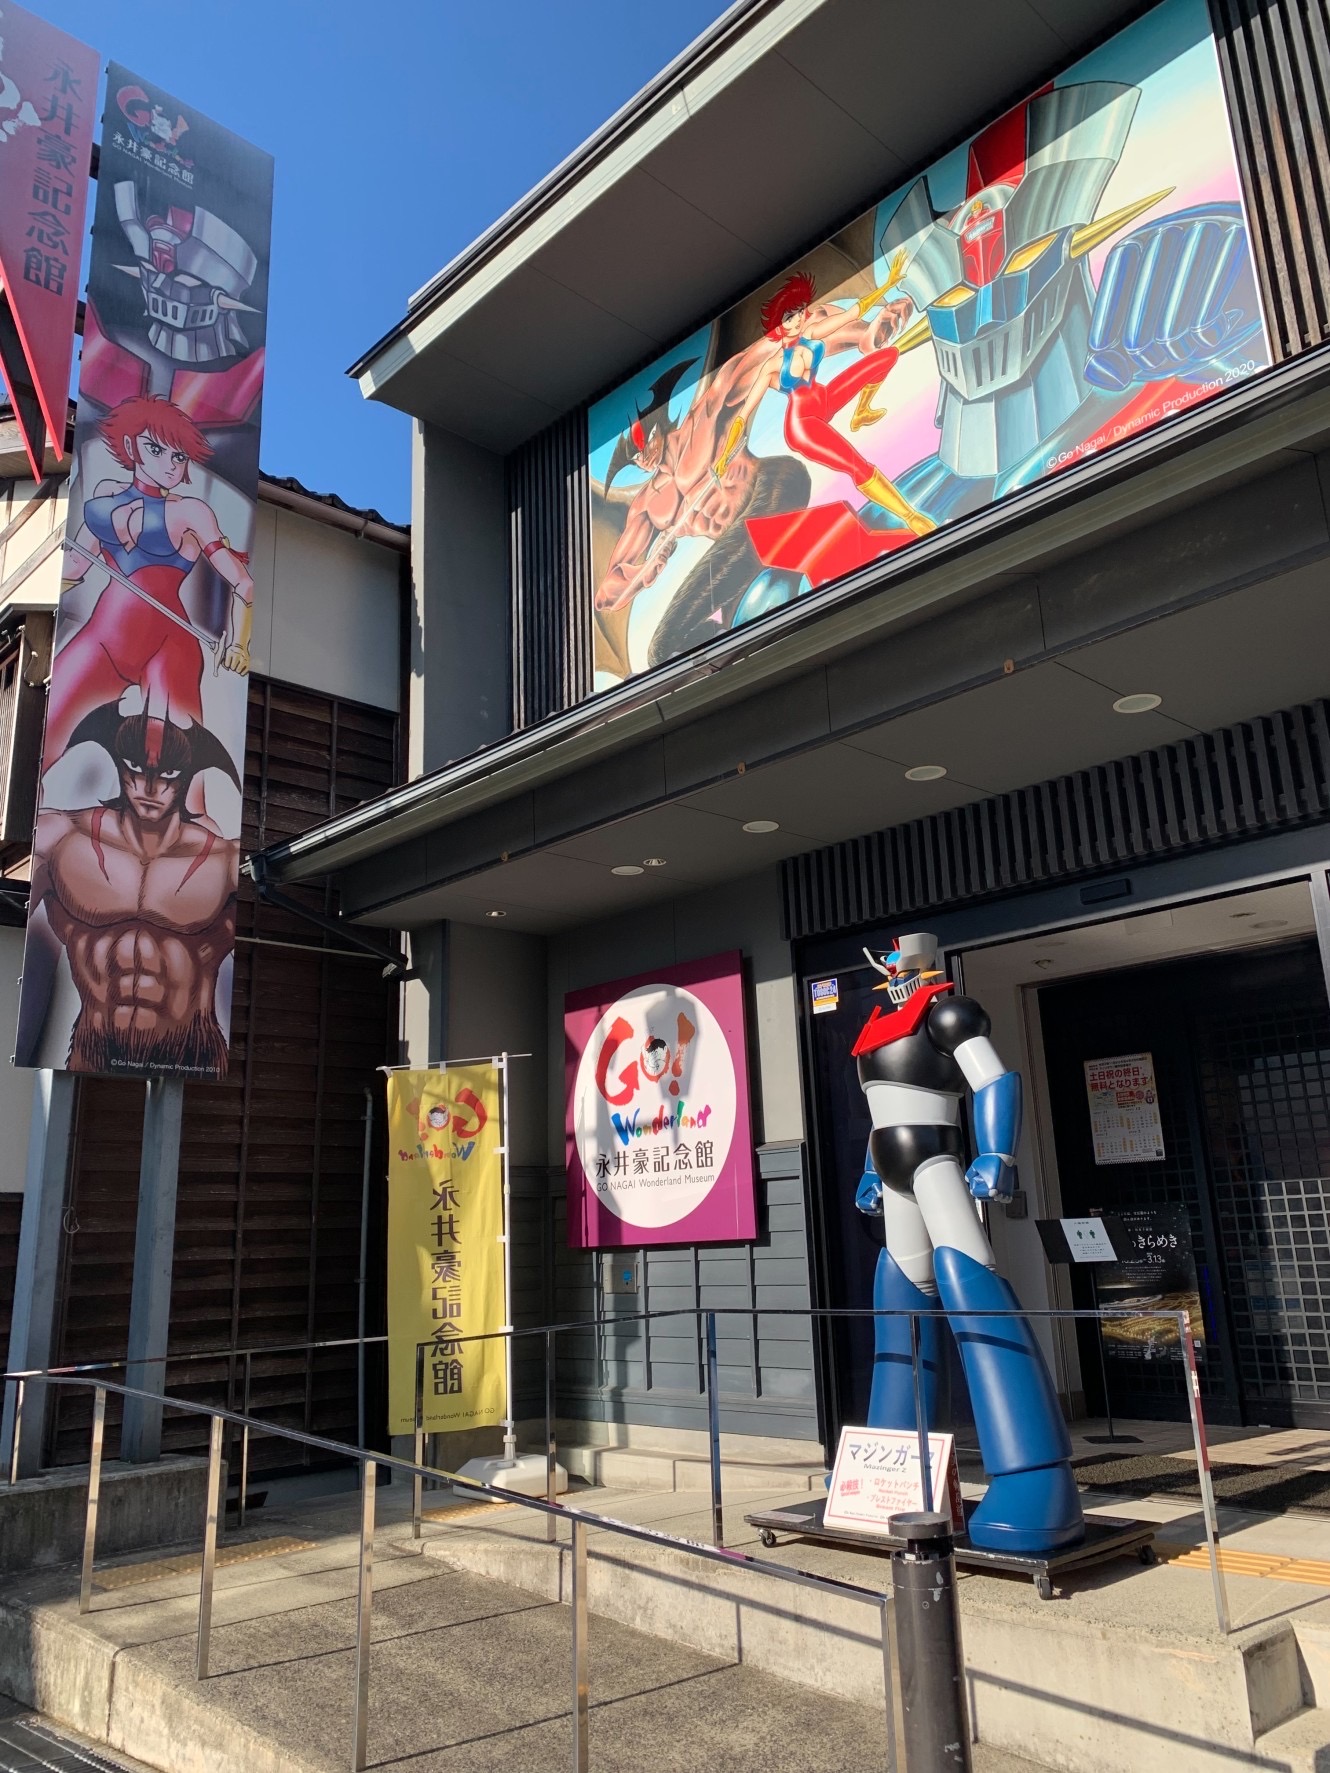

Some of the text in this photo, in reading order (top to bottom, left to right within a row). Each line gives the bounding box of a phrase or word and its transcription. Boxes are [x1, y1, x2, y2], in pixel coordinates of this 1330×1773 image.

[23, 57, 82, 297] 永井豪記念館
[1162, 377, 1224, 412] Production
[1225, 360, 1255, 383] 2020
[149, 1062, 174, 1070] Dynamic
[174, 1063, 205, 1073] Production
[611, 1100, 712, 1146] Wonderland
[595, 1139, 714, 1178] 永井豪記念館
[596, 1173, 715, 1192] GO NAGAI Wonderland Museum
[863, 1463, 899, 1473] Mazinger
